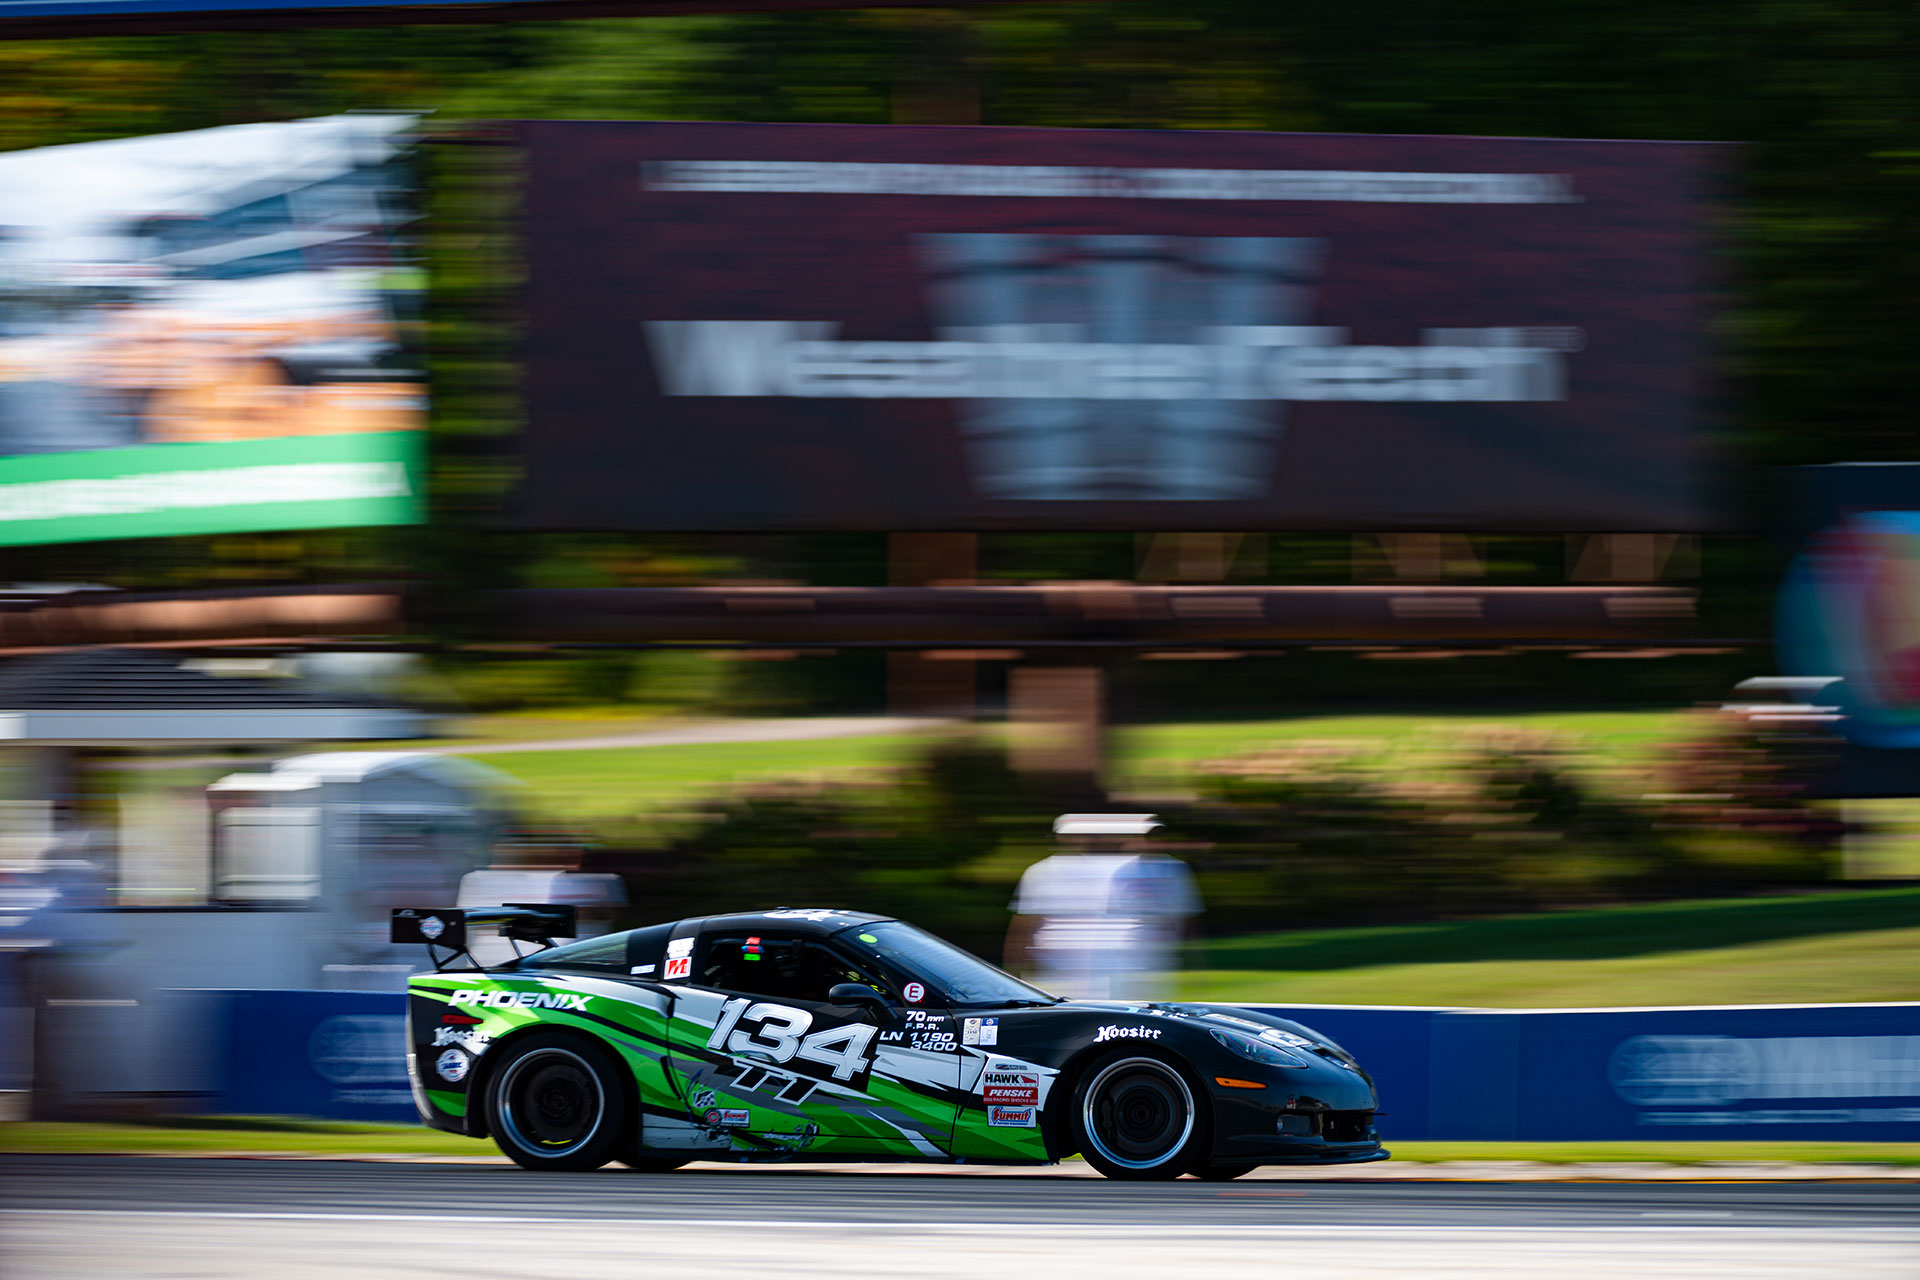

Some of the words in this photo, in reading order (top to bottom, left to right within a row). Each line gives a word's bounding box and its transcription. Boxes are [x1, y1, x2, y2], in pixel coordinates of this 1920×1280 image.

[908, 985, 920, 998] E
[448, 989, 594, 1011] PHOENIX
[906, 1011, 926, 1022] 70
[905, 1022, 940, 1030] F.P.R.
[706, 998, 878, 1080] 134
[879, 1031, 904, 1041] LN
[910, 1032, 954, 1042] 1190
[1093, 1024, 1162, 1043] Hoosier
[910, 1041, 957, 1051] 3400
[985, 1073, 1020, 1083] HAWK
[989, 1089, 1034, 1097] PENSKE
